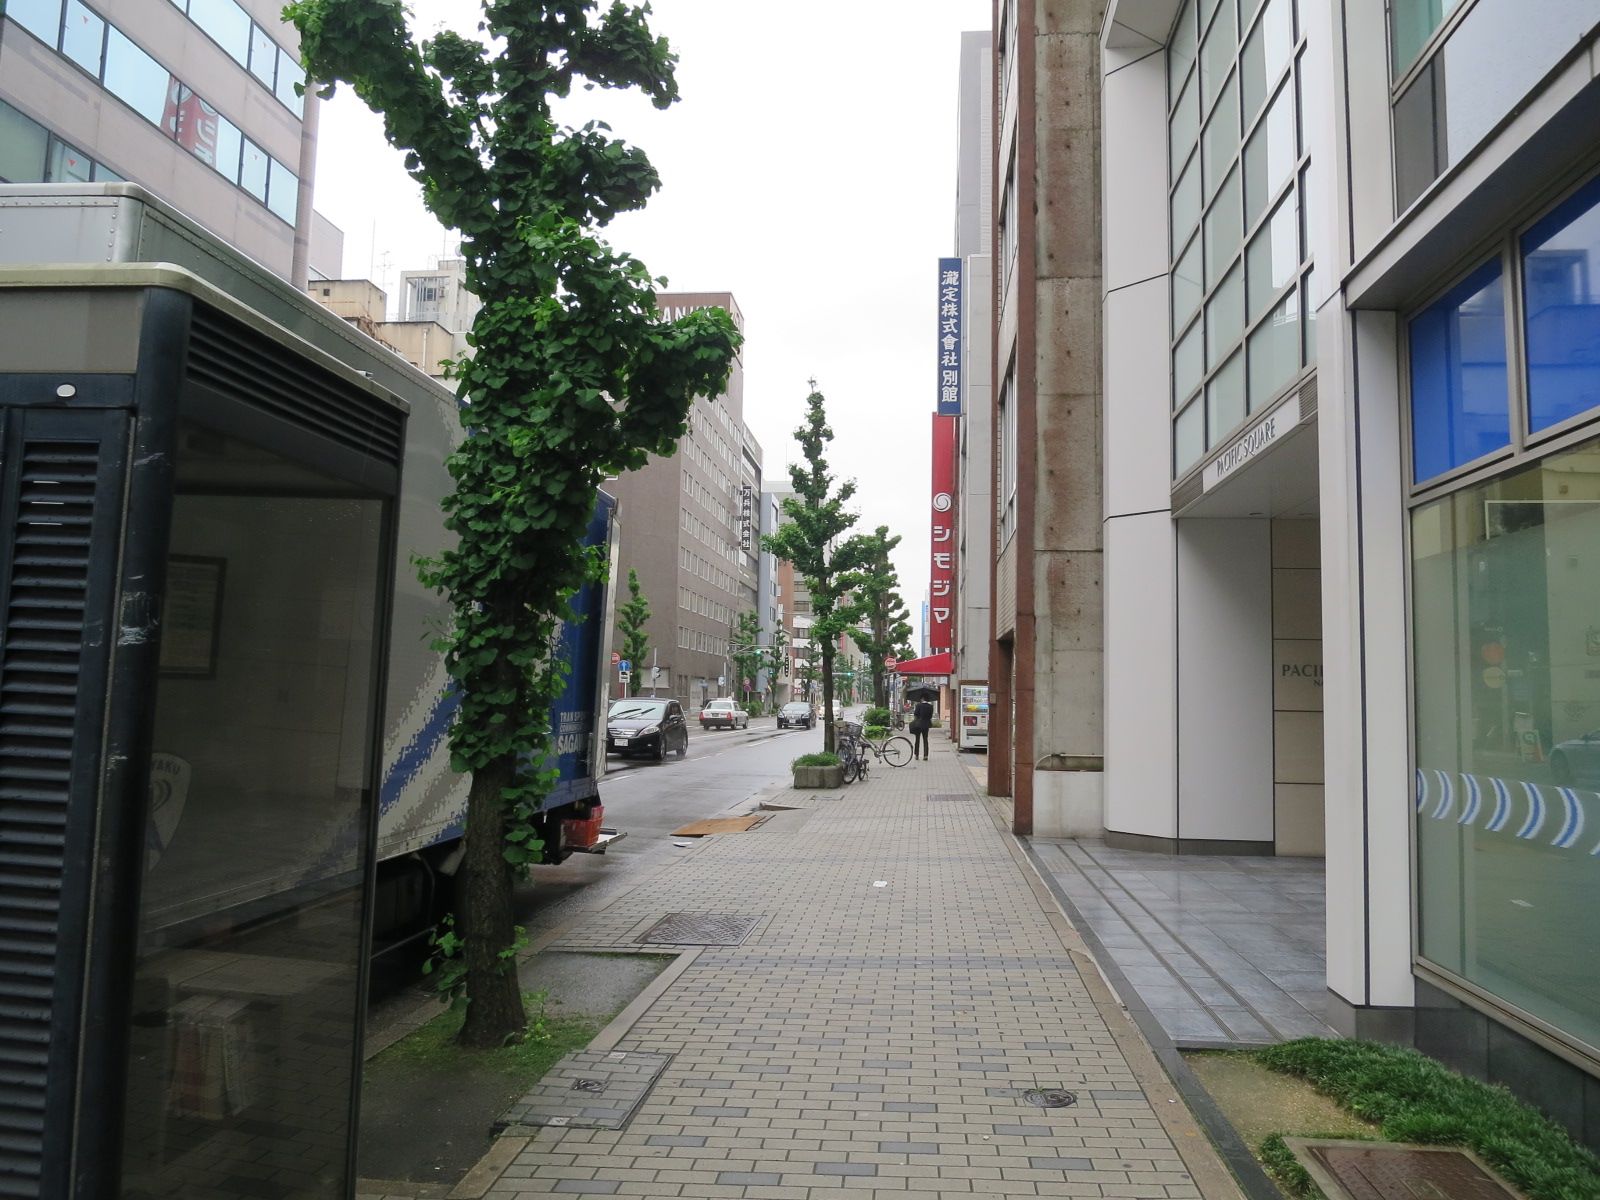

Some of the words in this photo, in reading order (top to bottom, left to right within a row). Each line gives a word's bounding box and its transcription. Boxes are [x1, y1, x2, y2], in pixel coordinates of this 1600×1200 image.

[1216, 443, 1243, 478] PACIFIC
[1244, 417, 1276, 456] SQUARE
[933, 525, 951, 624] シモジマ
[1281, 664, 1324, 678] PACI
